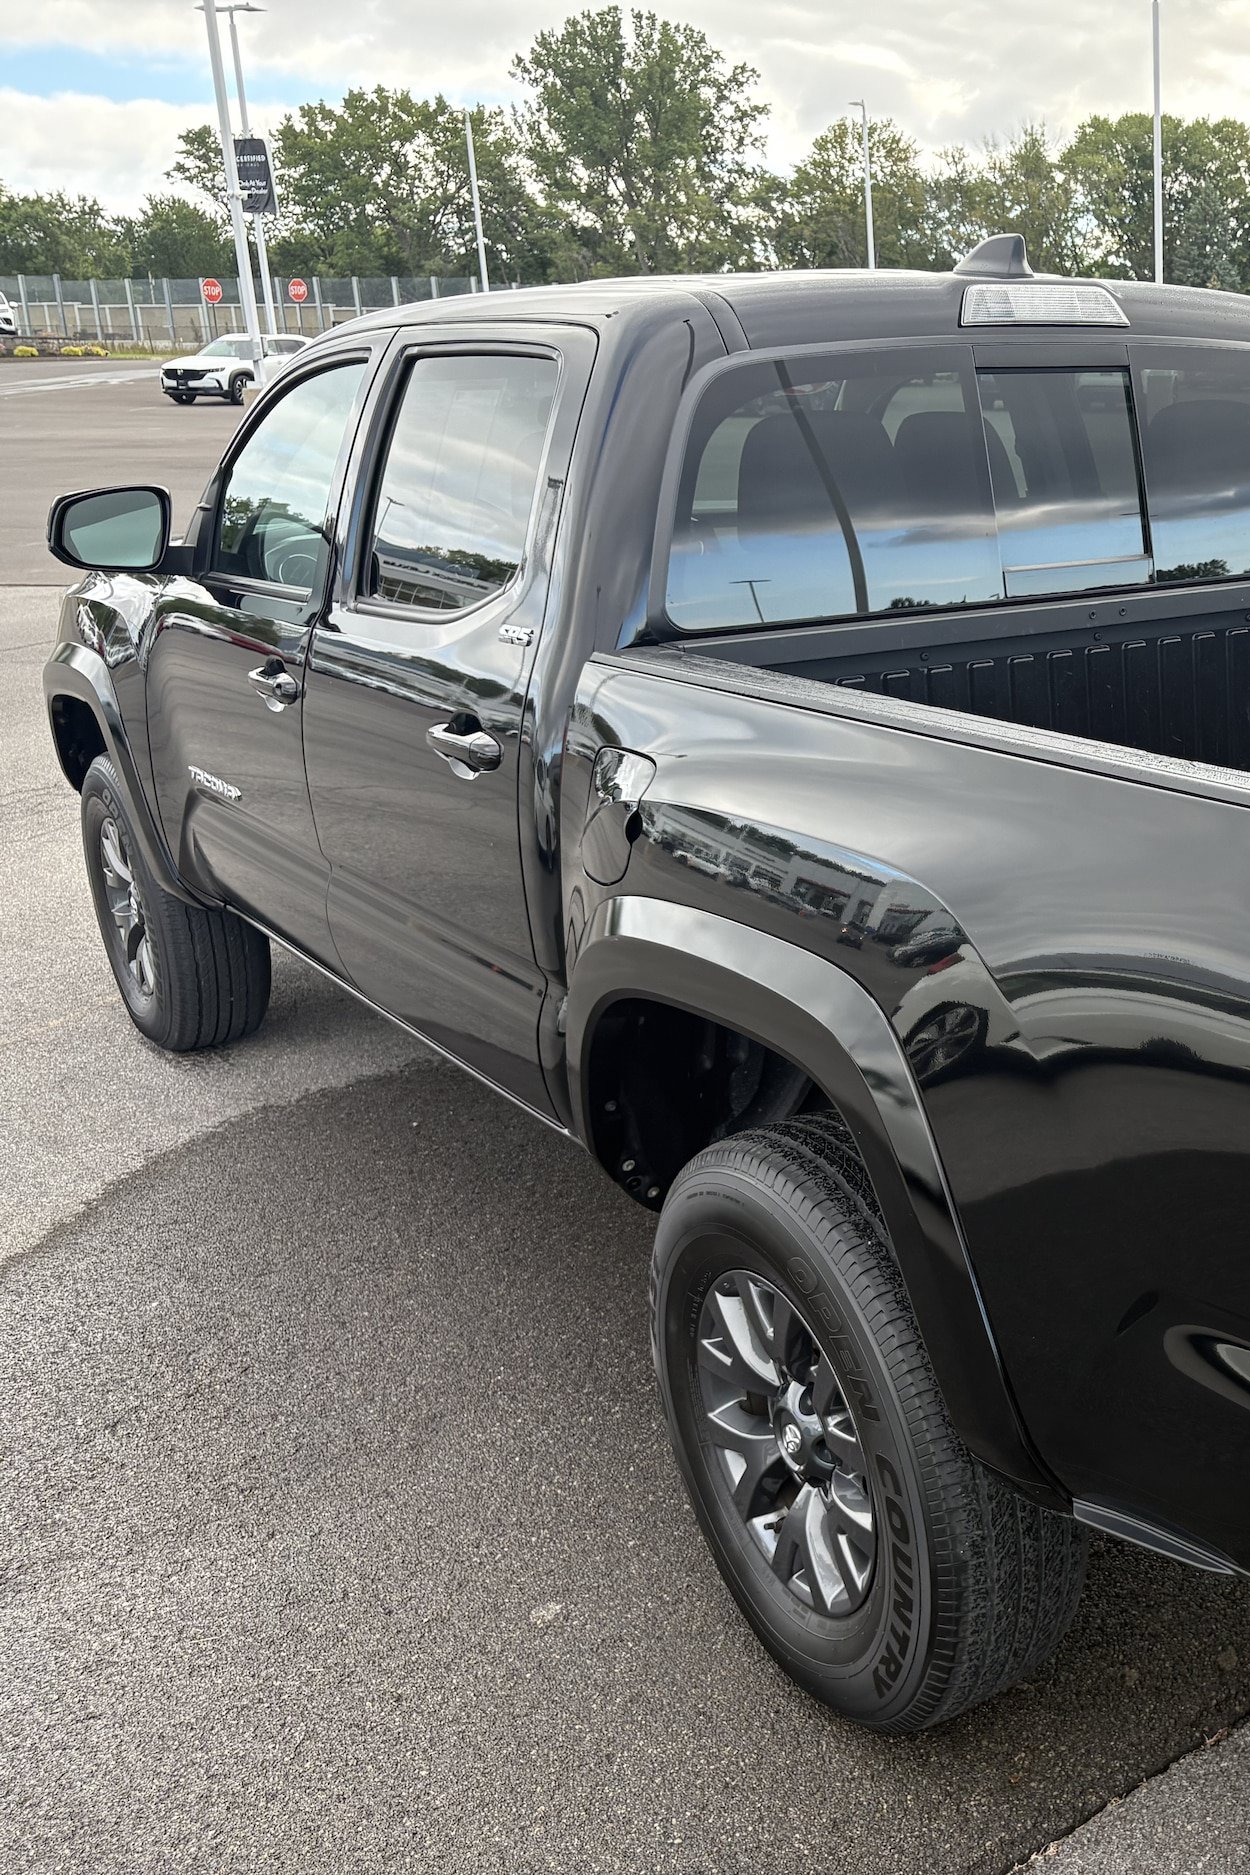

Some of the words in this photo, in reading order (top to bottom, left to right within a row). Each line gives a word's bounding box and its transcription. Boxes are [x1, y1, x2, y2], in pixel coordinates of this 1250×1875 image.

[203, 286, 220, 296] STOP
[290, 286, 307, 295] STOP
[499, 624, 534, 647] SR5
[188, 765, 242, 801] TACOMA
[788, 1257, 881, 1424] OPEN
[875, 1453, 915, 1700] COUNTRY
